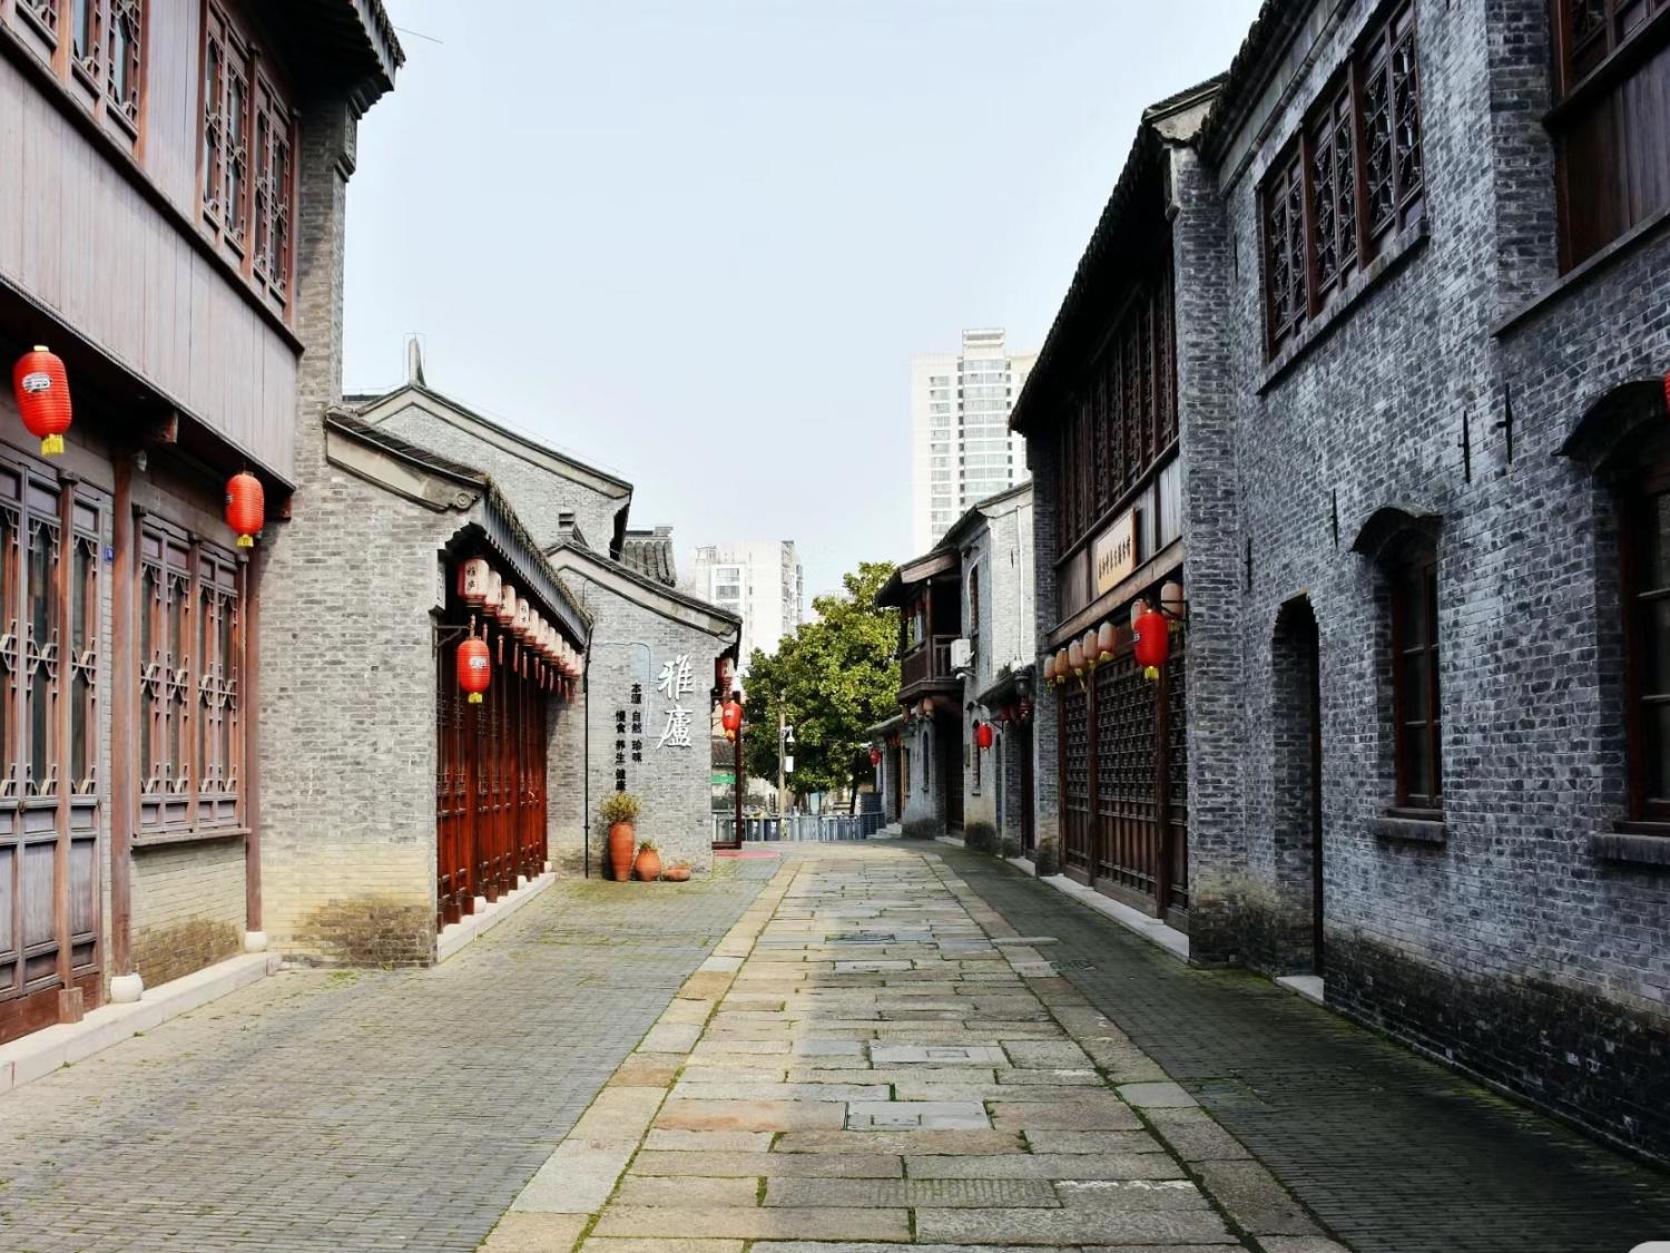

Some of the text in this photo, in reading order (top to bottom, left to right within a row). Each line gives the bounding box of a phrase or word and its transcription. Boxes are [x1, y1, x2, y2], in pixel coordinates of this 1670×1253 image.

[632, 710, 642, 734] 自然
[615, 739, 626, 765] 养生
[615, 768, 626, 791] 健康
